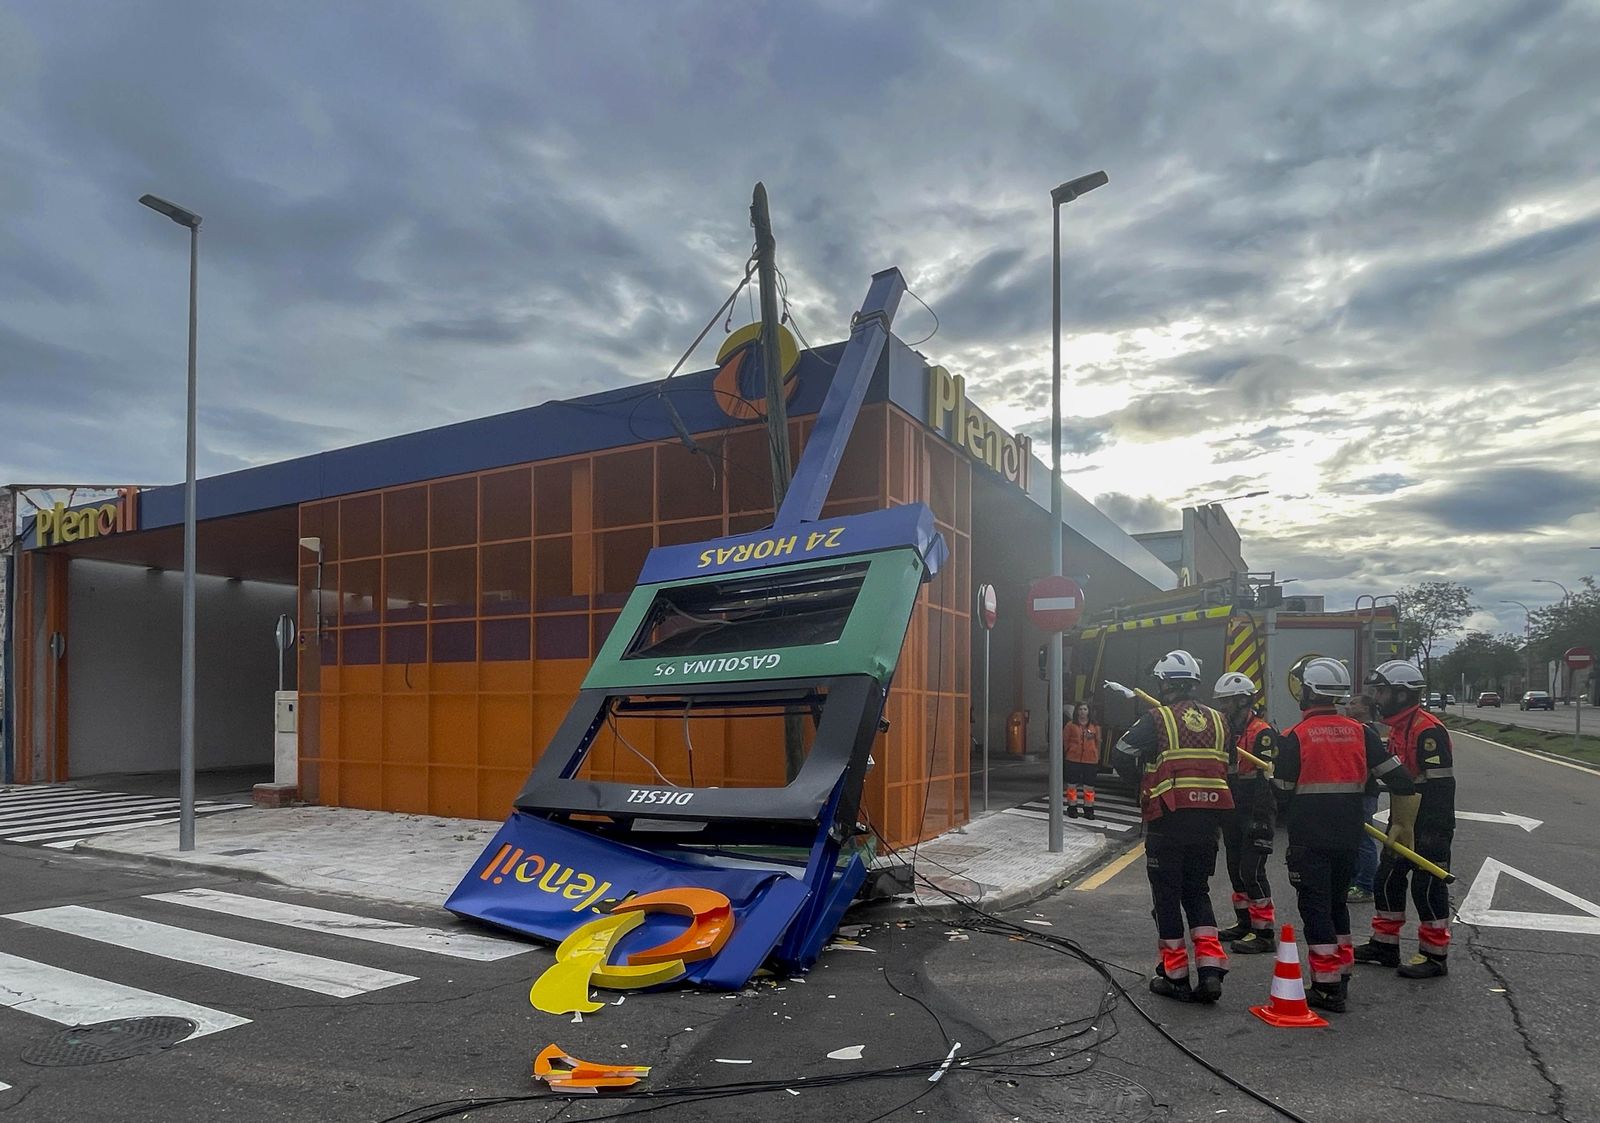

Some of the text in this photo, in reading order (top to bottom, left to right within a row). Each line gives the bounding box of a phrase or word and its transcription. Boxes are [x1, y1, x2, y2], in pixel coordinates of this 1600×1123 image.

[928, 365, 1033, 495] Plenoil
[36, 487, 138, 547] Plenoil
[697, 527, 847, 568] 24 HORAS
[654, 653, 781, 676] GASOLINA 95
[1307, 726, 1356, 737] BOMBEROS
[627, 789, 695, 806] DIESEL
[480, 844, 617, 914] lenoil
